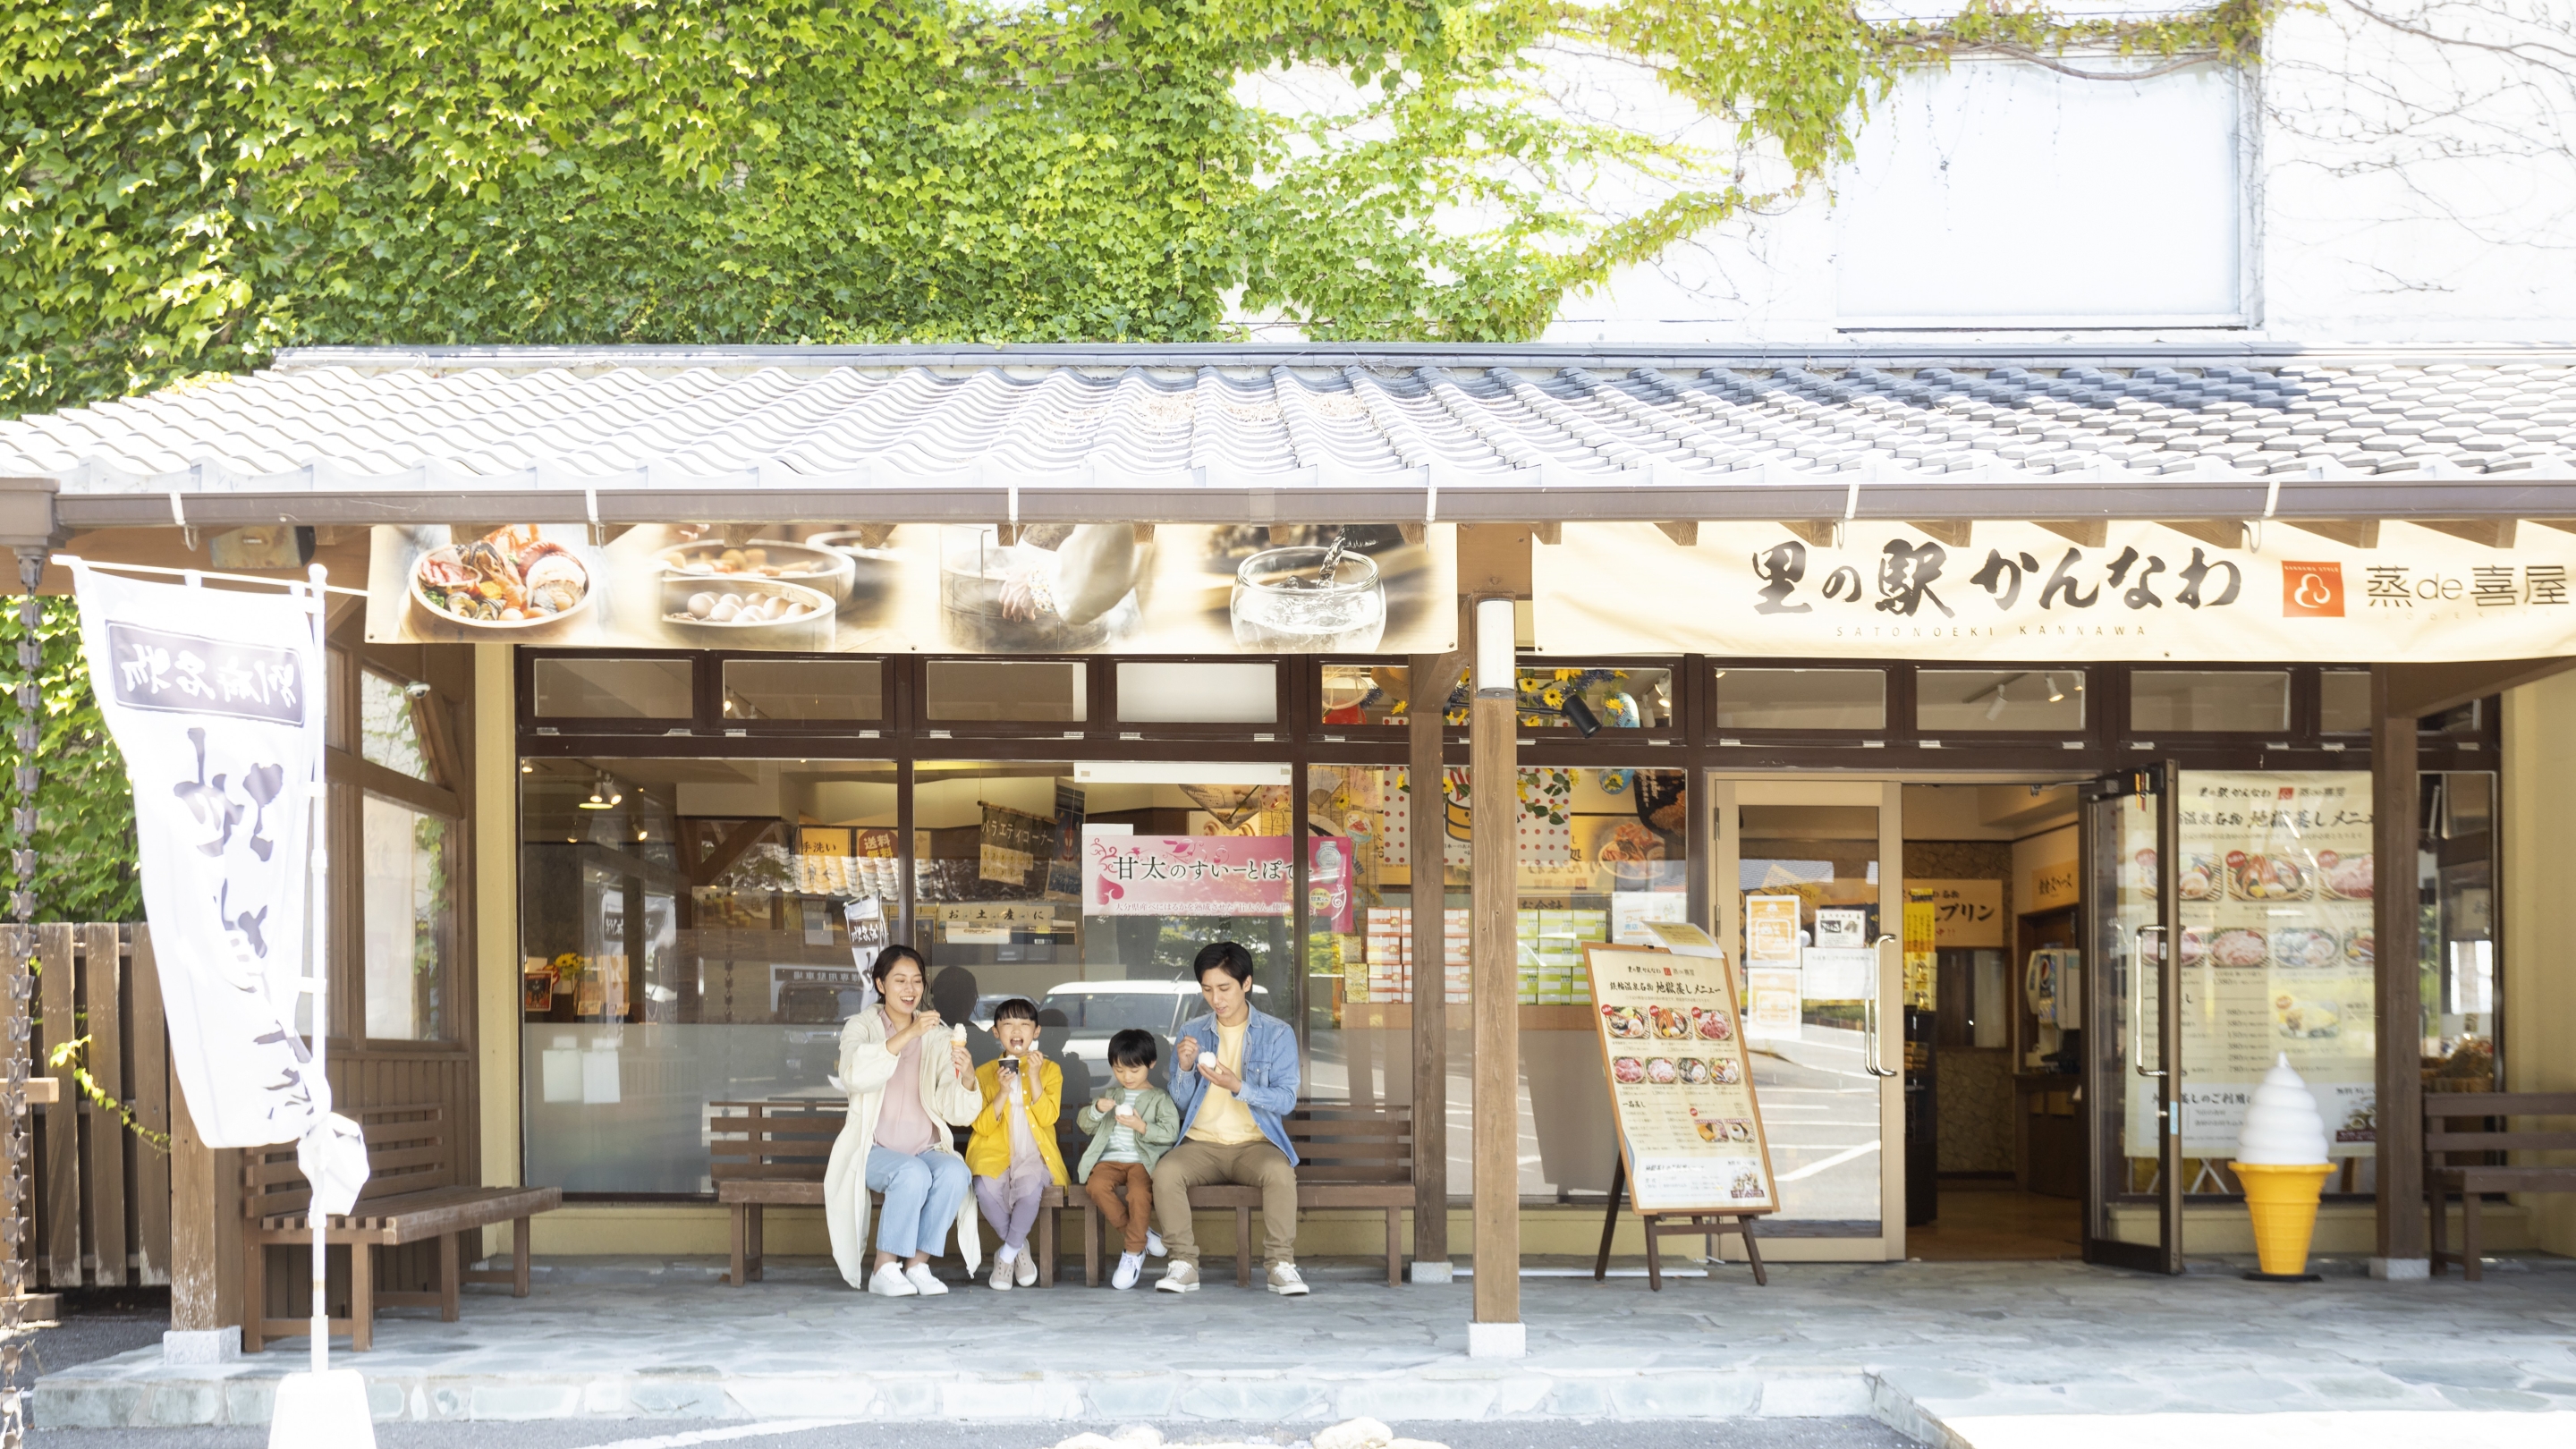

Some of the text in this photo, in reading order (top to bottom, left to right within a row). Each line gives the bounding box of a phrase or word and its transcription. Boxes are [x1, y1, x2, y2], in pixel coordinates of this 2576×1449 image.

[1836, 623, 2147, 638] SATONOEKI KANNAWA
[981, 819, 1054, 846] バラエティコーナー
[864, 834, 891, 850] 送料
[948, 909, 1045, 921] お土産に
[1935, 903, 1996, 922] プリン
